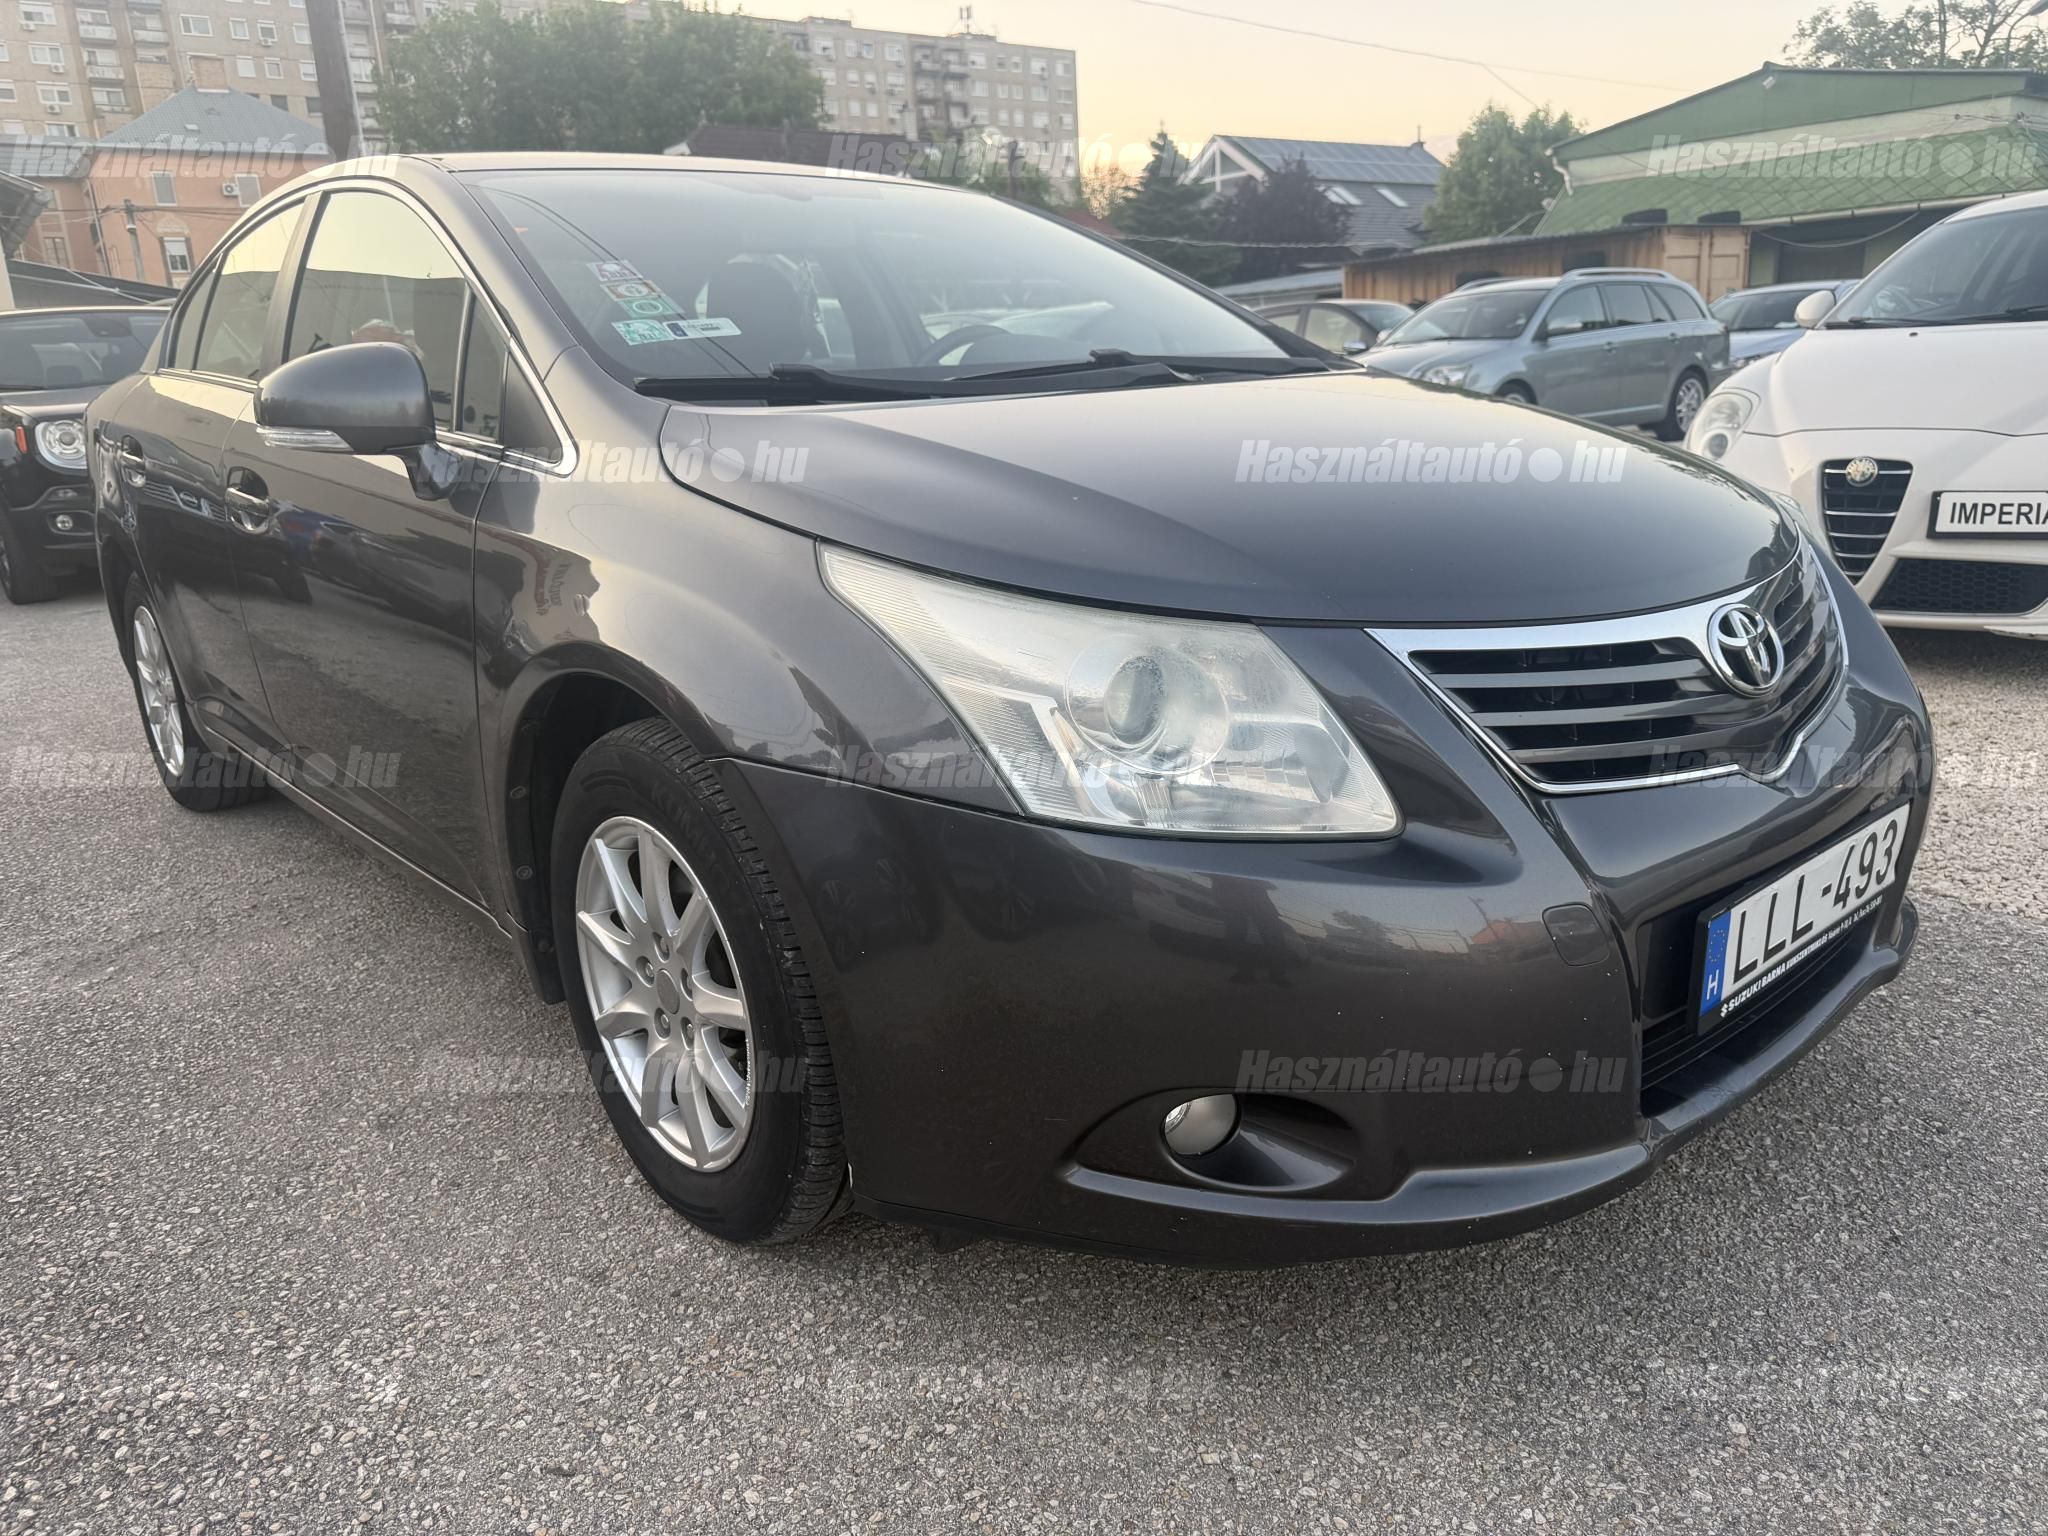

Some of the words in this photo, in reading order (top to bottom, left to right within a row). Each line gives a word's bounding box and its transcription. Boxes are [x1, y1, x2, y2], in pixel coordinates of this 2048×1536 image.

[1733, 819, 1898, 985] LLL-493
[1706, 969, 1719, 1001] H
[1728, 981, 1761, 1012] SUZUKI
[1761, 962, 1786, 989] BARNA
